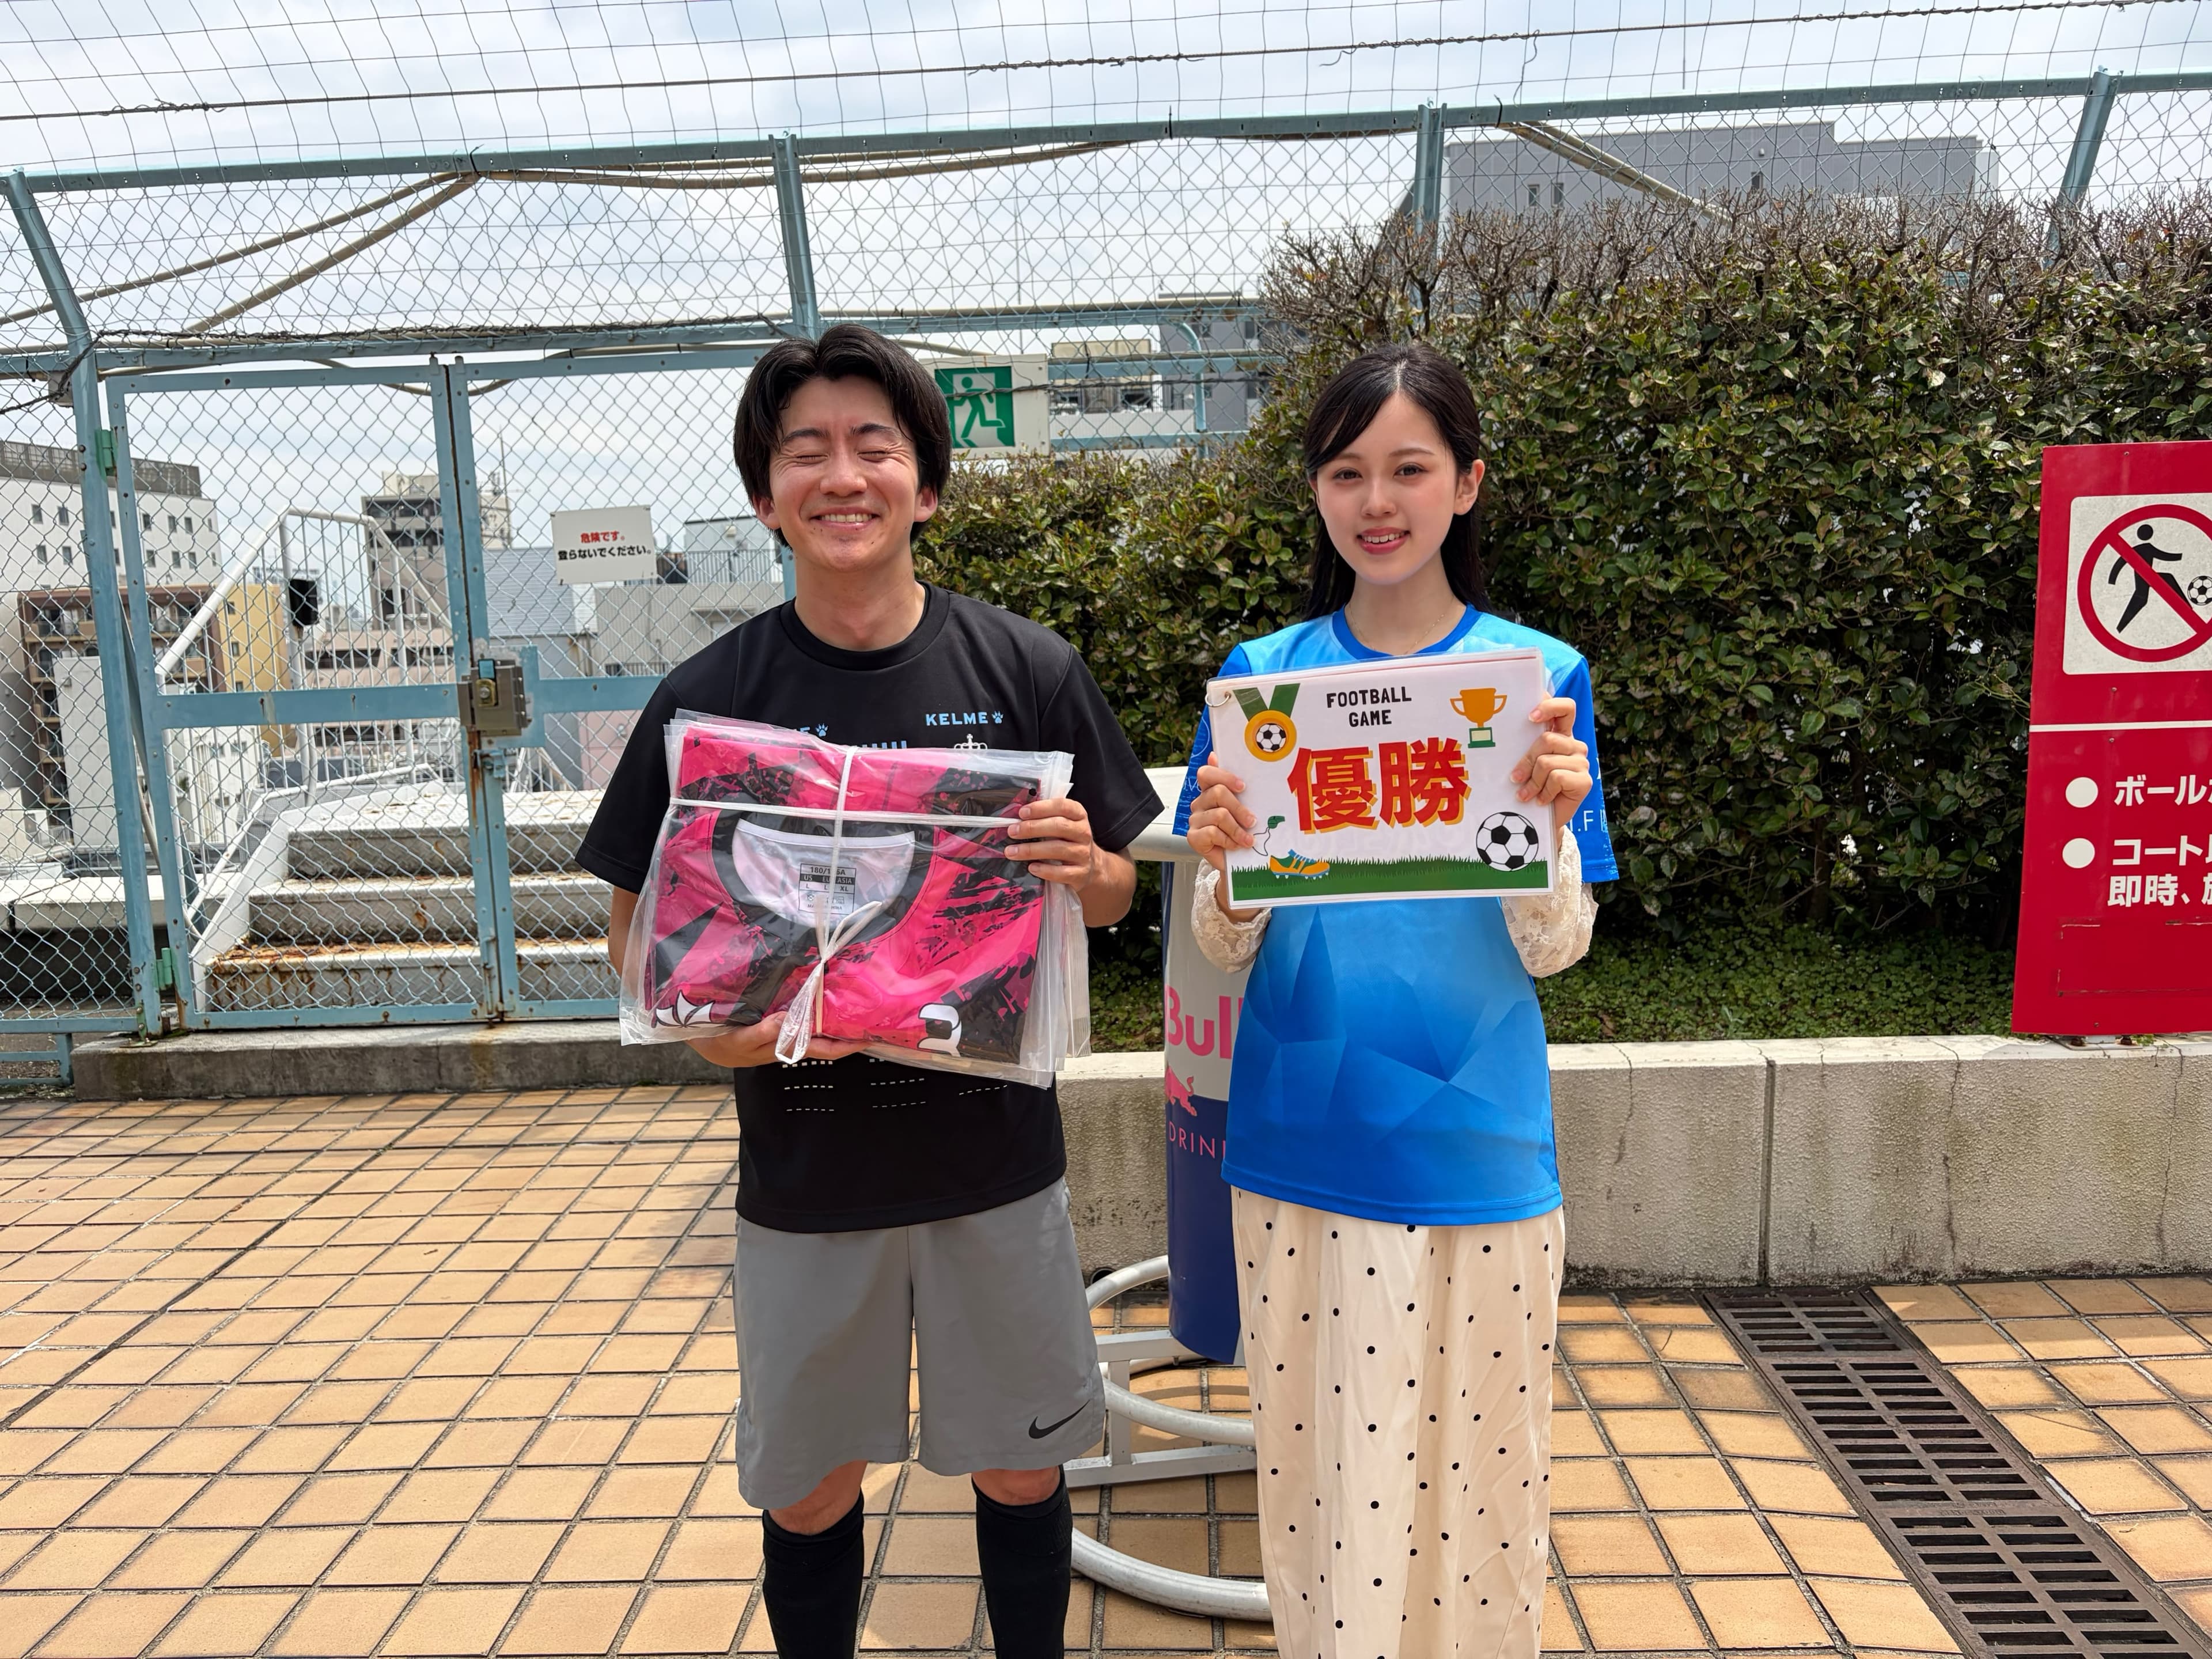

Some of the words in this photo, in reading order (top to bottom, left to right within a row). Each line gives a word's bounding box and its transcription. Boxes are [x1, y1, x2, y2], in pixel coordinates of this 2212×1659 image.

[580, 531, 625, 543] 危険です。
[558, 545, 652, 560] 登らないでください。
[1326, 686, 1412, 709] FOOTBALL
[925, 711, 988, 726] KELME
[1349, 709, 1392, 728] GAME
[1287, 737, 1472, 834] 優勝
[2114, 774, 2212, 806] ボール
[2112, 834, 2212, 866] コート
[1168, 1120, 1226, 1159] DRIN
